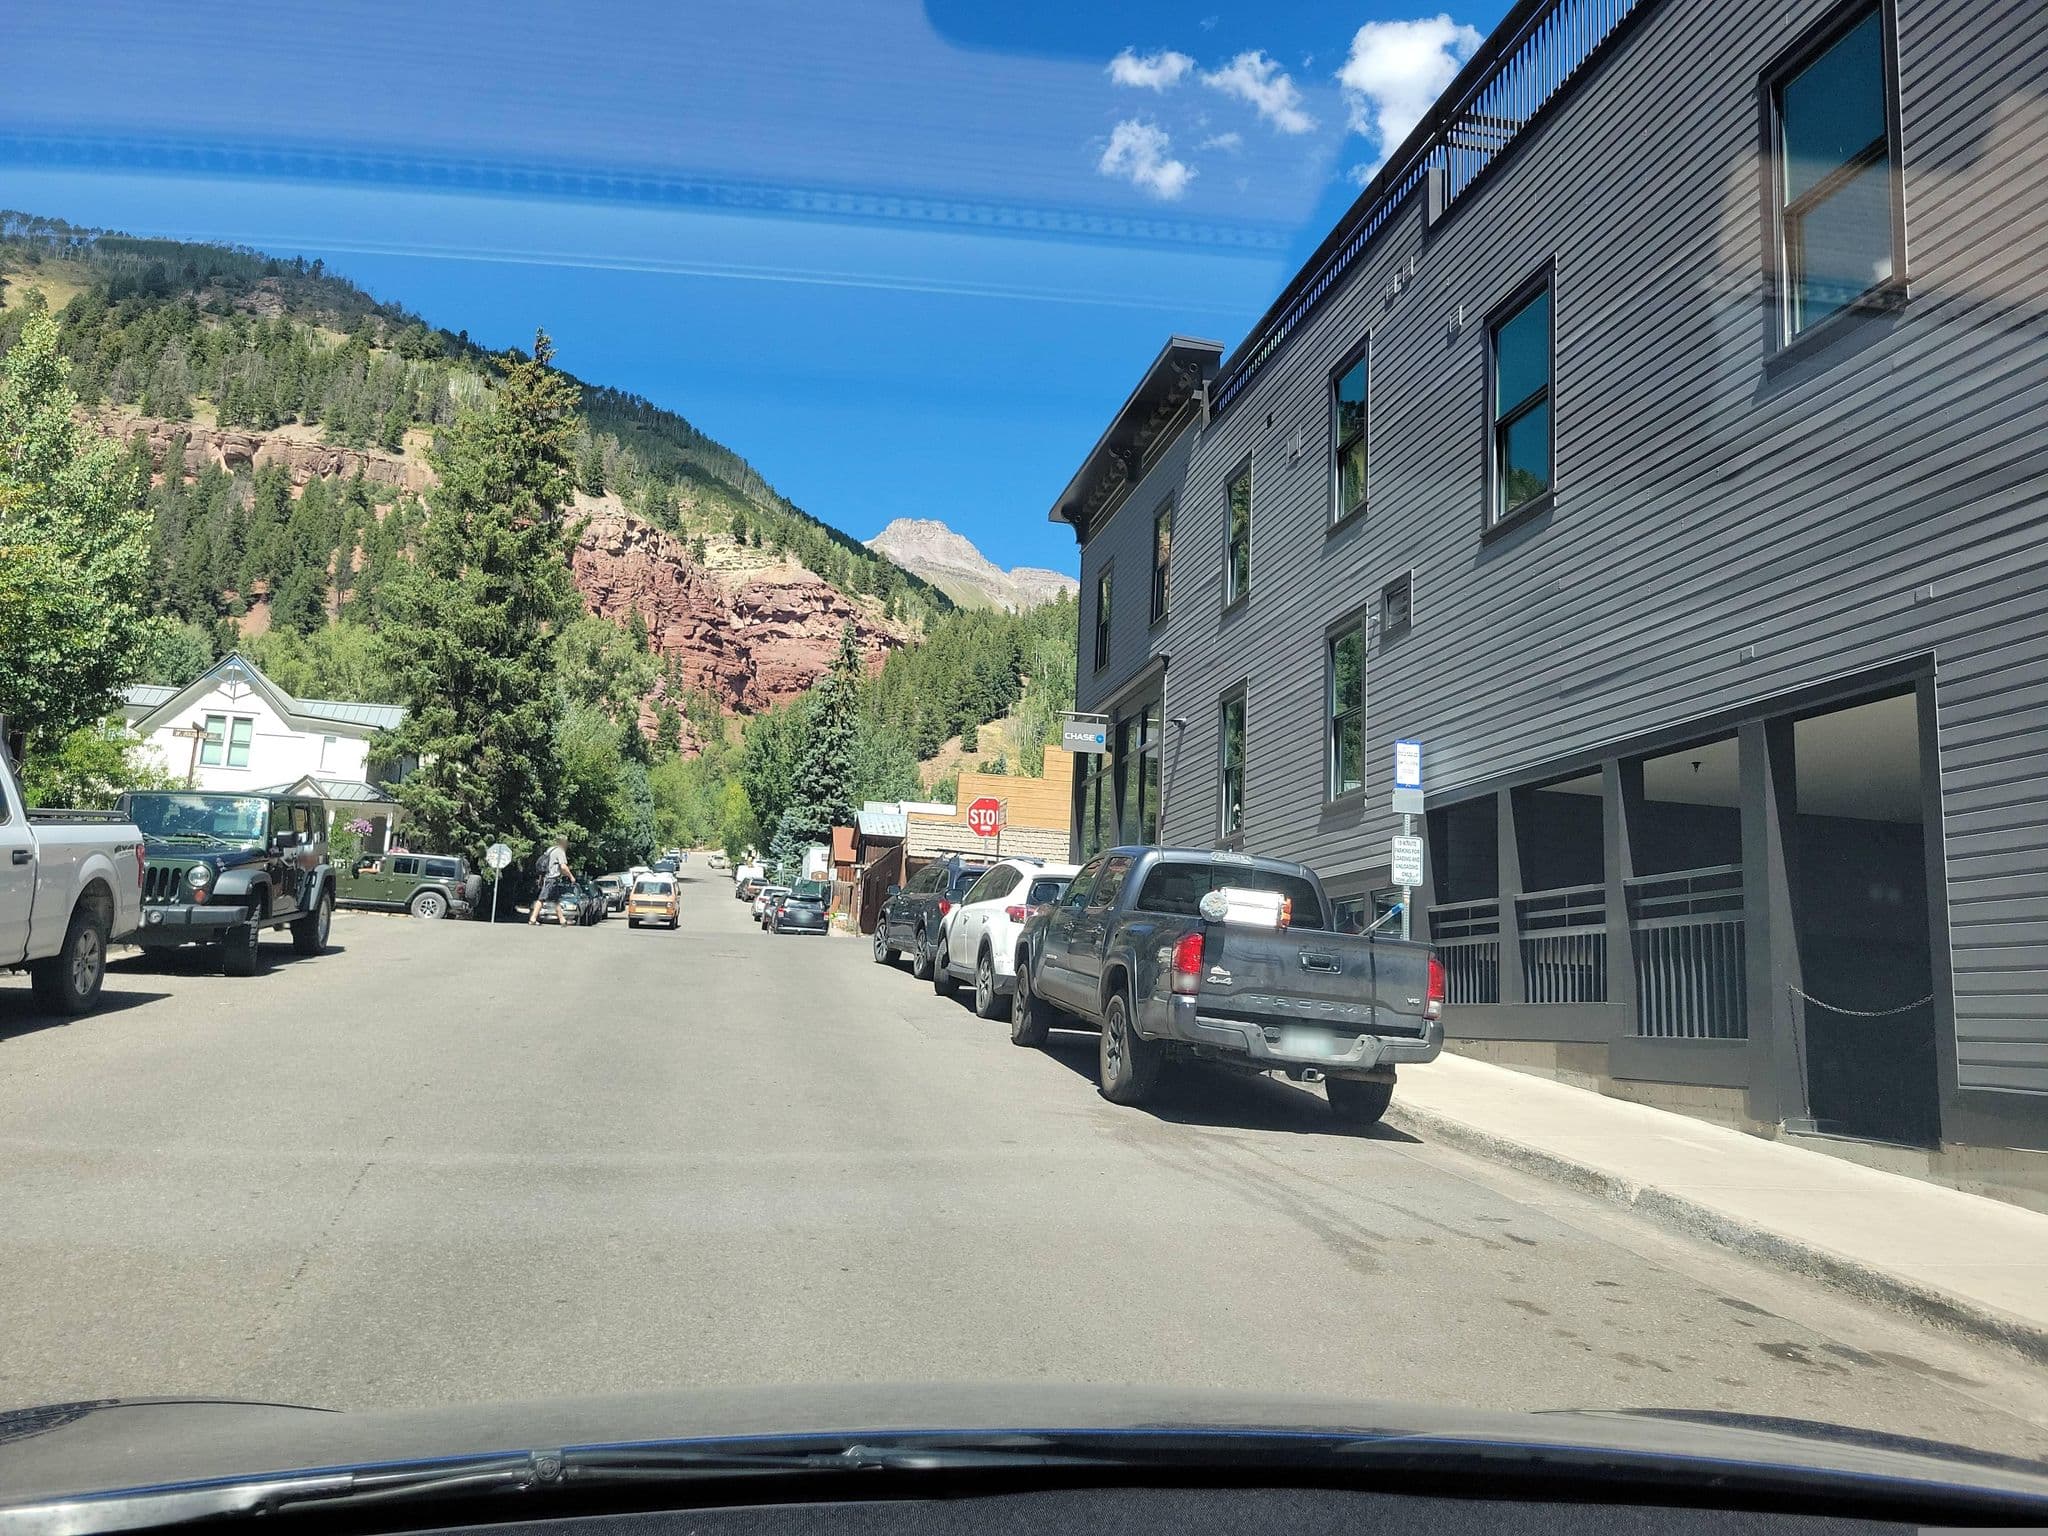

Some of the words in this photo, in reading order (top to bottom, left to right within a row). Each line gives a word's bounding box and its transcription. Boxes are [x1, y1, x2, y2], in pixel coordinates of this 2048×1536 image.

[1064, 732, 1095, 742] CHASE
[970, 809, 998, 825] STO
[1250, 994, 1379, 1015] TACOMA
[1406, 997, 1421, 1005] V6
